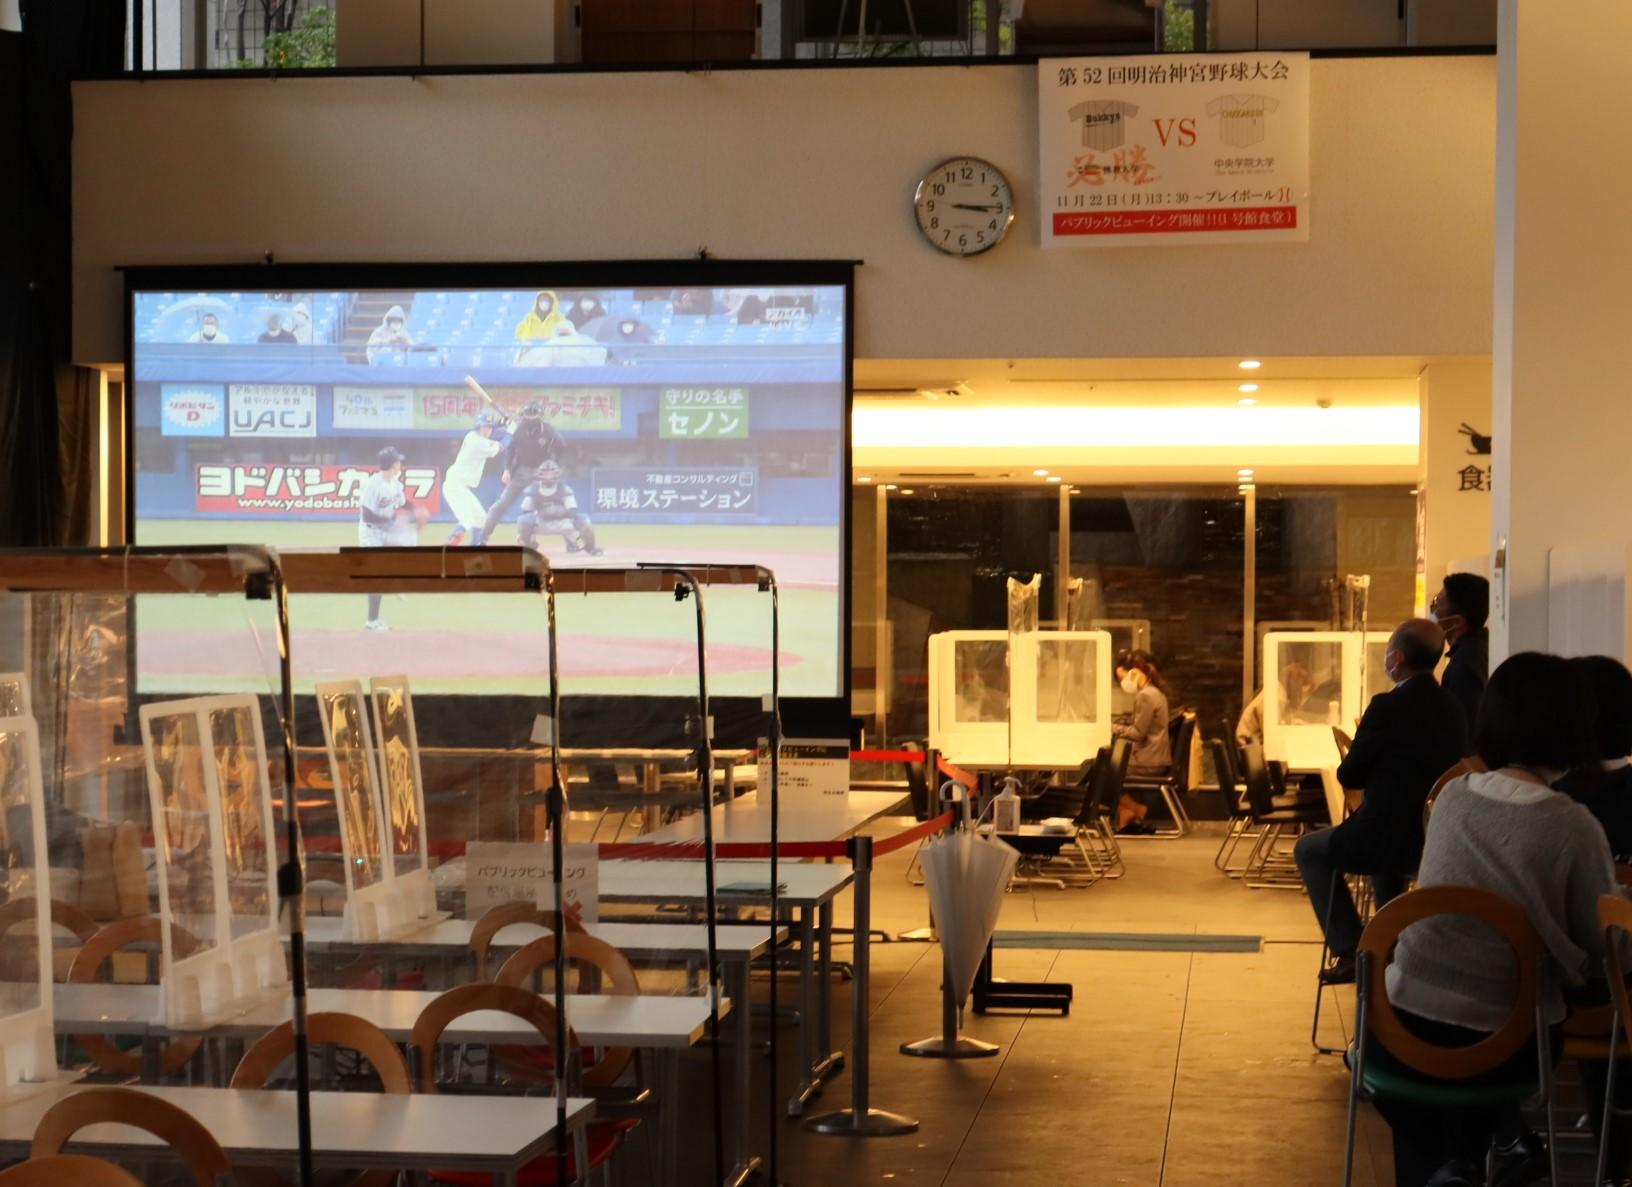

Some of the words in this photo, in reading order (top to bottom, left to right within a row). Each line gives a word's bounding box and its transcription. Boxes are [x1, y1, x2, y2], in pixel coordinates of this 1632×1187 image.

[1153, 117, 1197, 147] VS
[945, 172, 956, 183] 11
[960, 167, 973, 180] 12
[981, 173, 986, 184] 1
[932, 184, 945, 196] 10
[991, 185, 999, 197] 2
[927, 200, 935, 212] 9
[995, 202, 1003, 214] 3
[930, 216, 939, 229] 8
[988, 219, 997, 230] 4
[943, 229, 951, 241] 7
[959, 234, 967, 246] 6
[976, 231, 984, 243] 5
[665, 388, 744, 405] 守りの名手
[186, 411, 201, 422] D
[233, 409, 311, 432] UACJ
[668, 411, 740, 435] セノン
[198, 465, 437, 498] ヨドバシカラ
[646, 472, 738, 484] 不動産コンサルティング
[1457, 464, 1491, 491] 食
[597, 487, 752, 509] 環境ステーション
[478, 865, 586, 879] パブリックビューング
